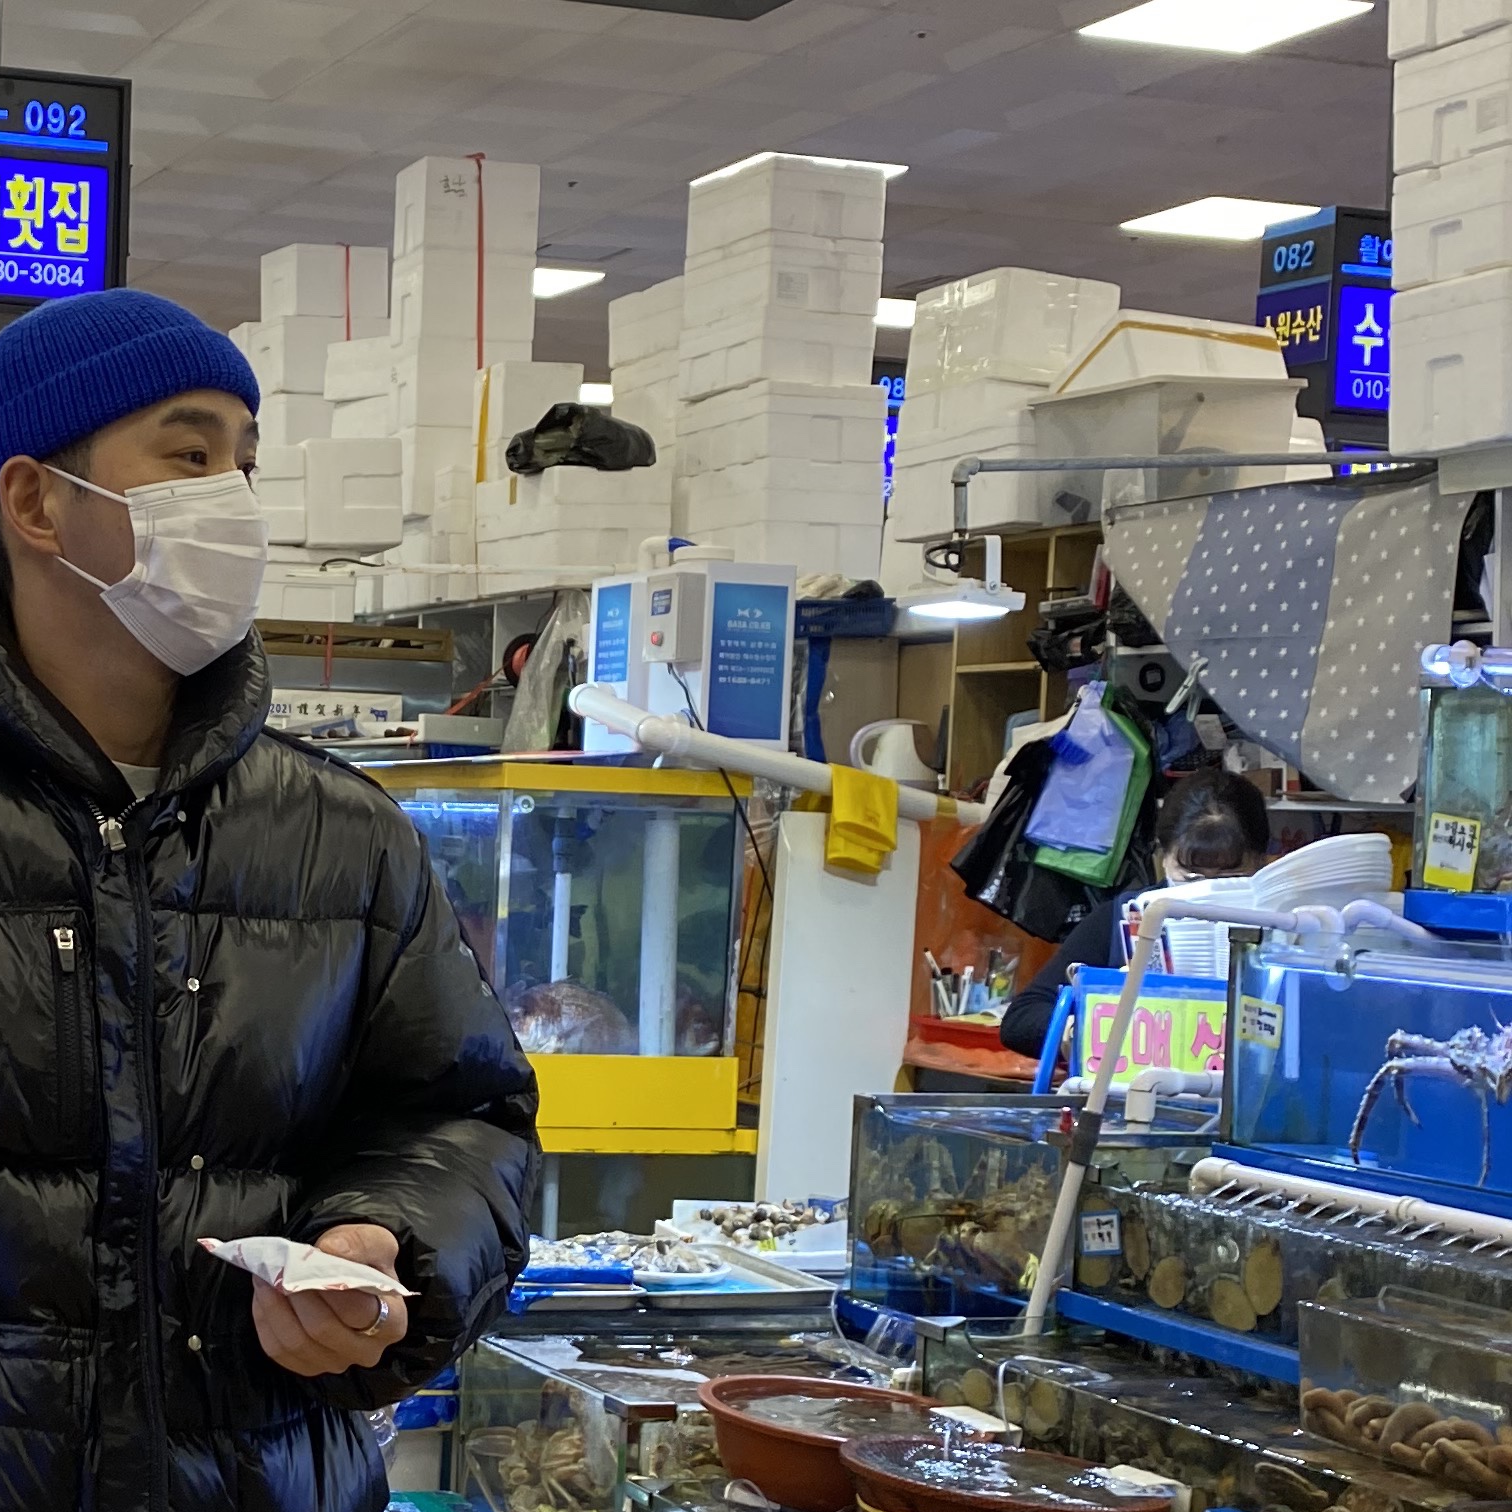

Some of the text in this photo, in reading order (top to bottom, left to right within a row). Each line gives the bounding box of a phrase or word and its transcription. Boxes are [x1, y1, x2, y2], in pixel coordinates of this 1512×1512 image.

[24, 100, 87, 138] 092
[1273, 240, 1315, 273] 082
[269, 704, 292, 714] 2021
